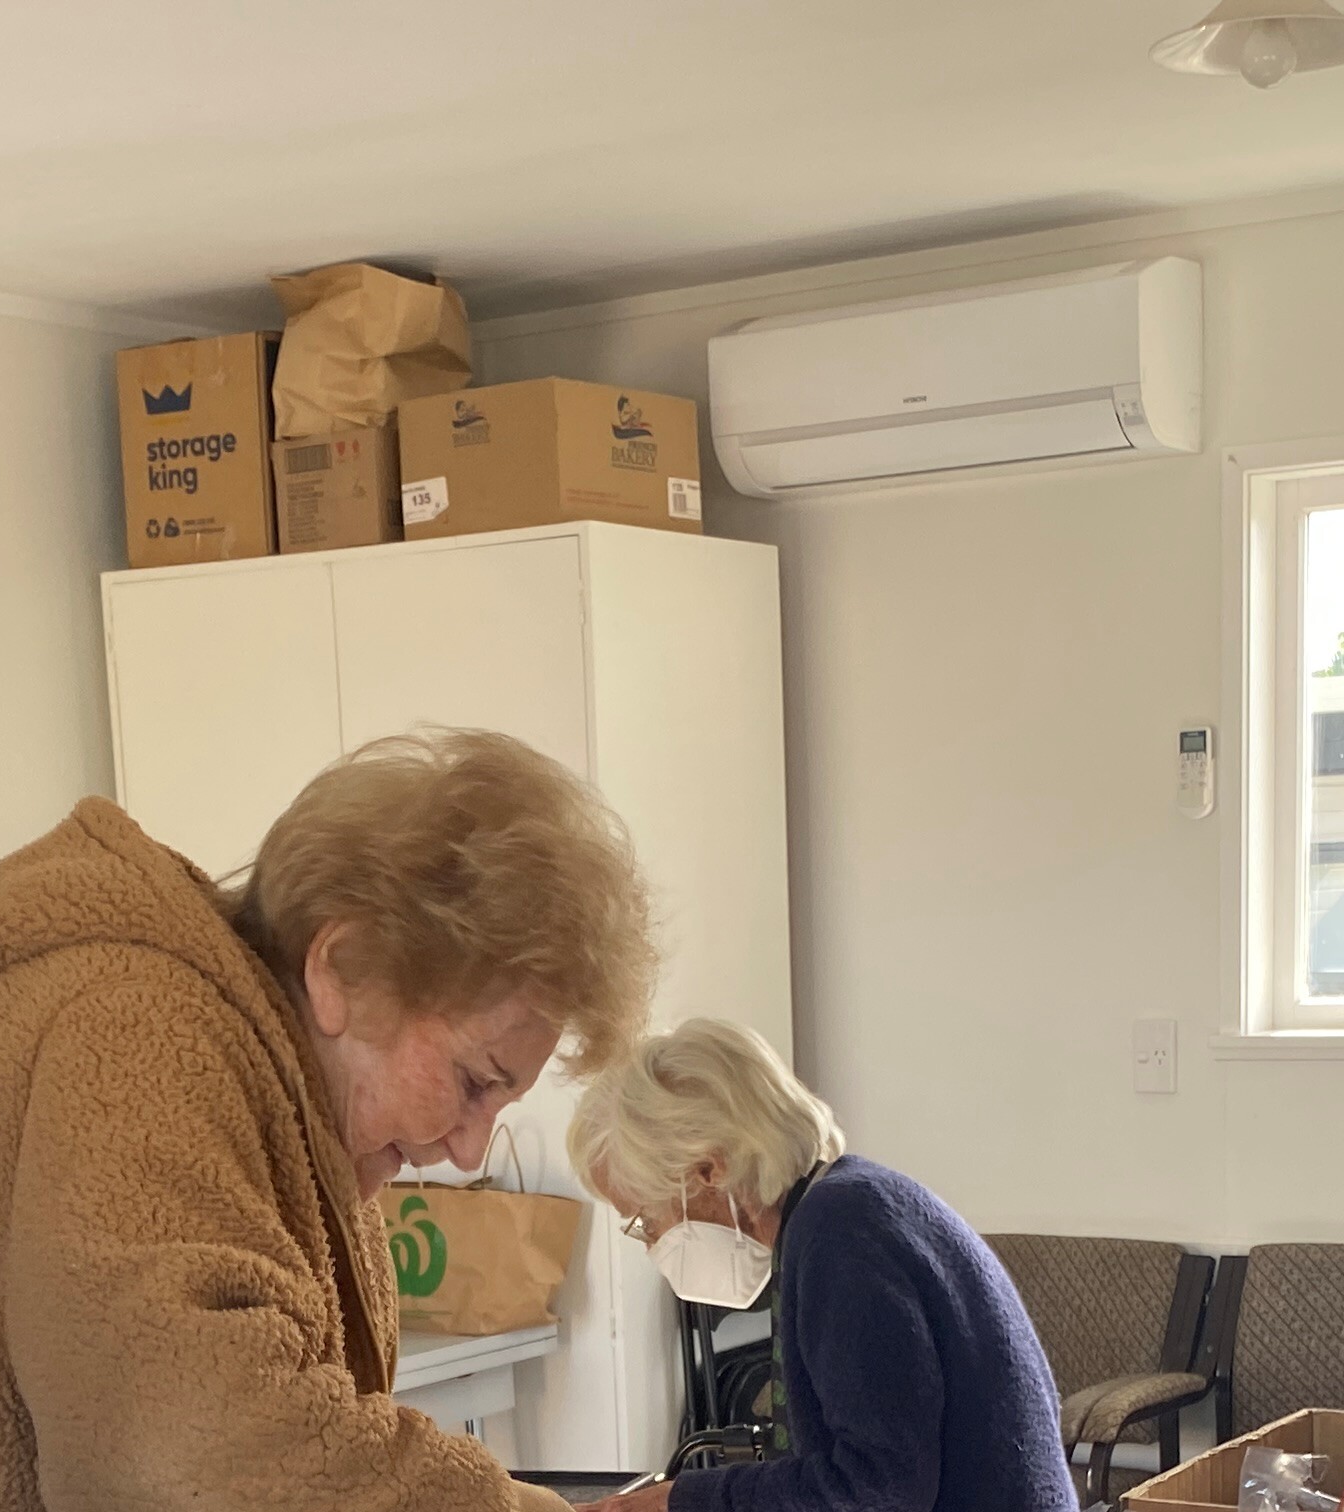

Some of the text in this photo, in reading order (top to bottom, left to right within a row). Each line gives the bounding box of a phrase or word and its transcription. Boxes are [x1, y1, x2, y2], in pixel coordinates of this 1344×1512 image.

[147, 432, 237, 462] storage
[612, 446, 656, 467] BAKERY
[148, 463, 198, 494] king
[411, 492, 431, 507] 135
